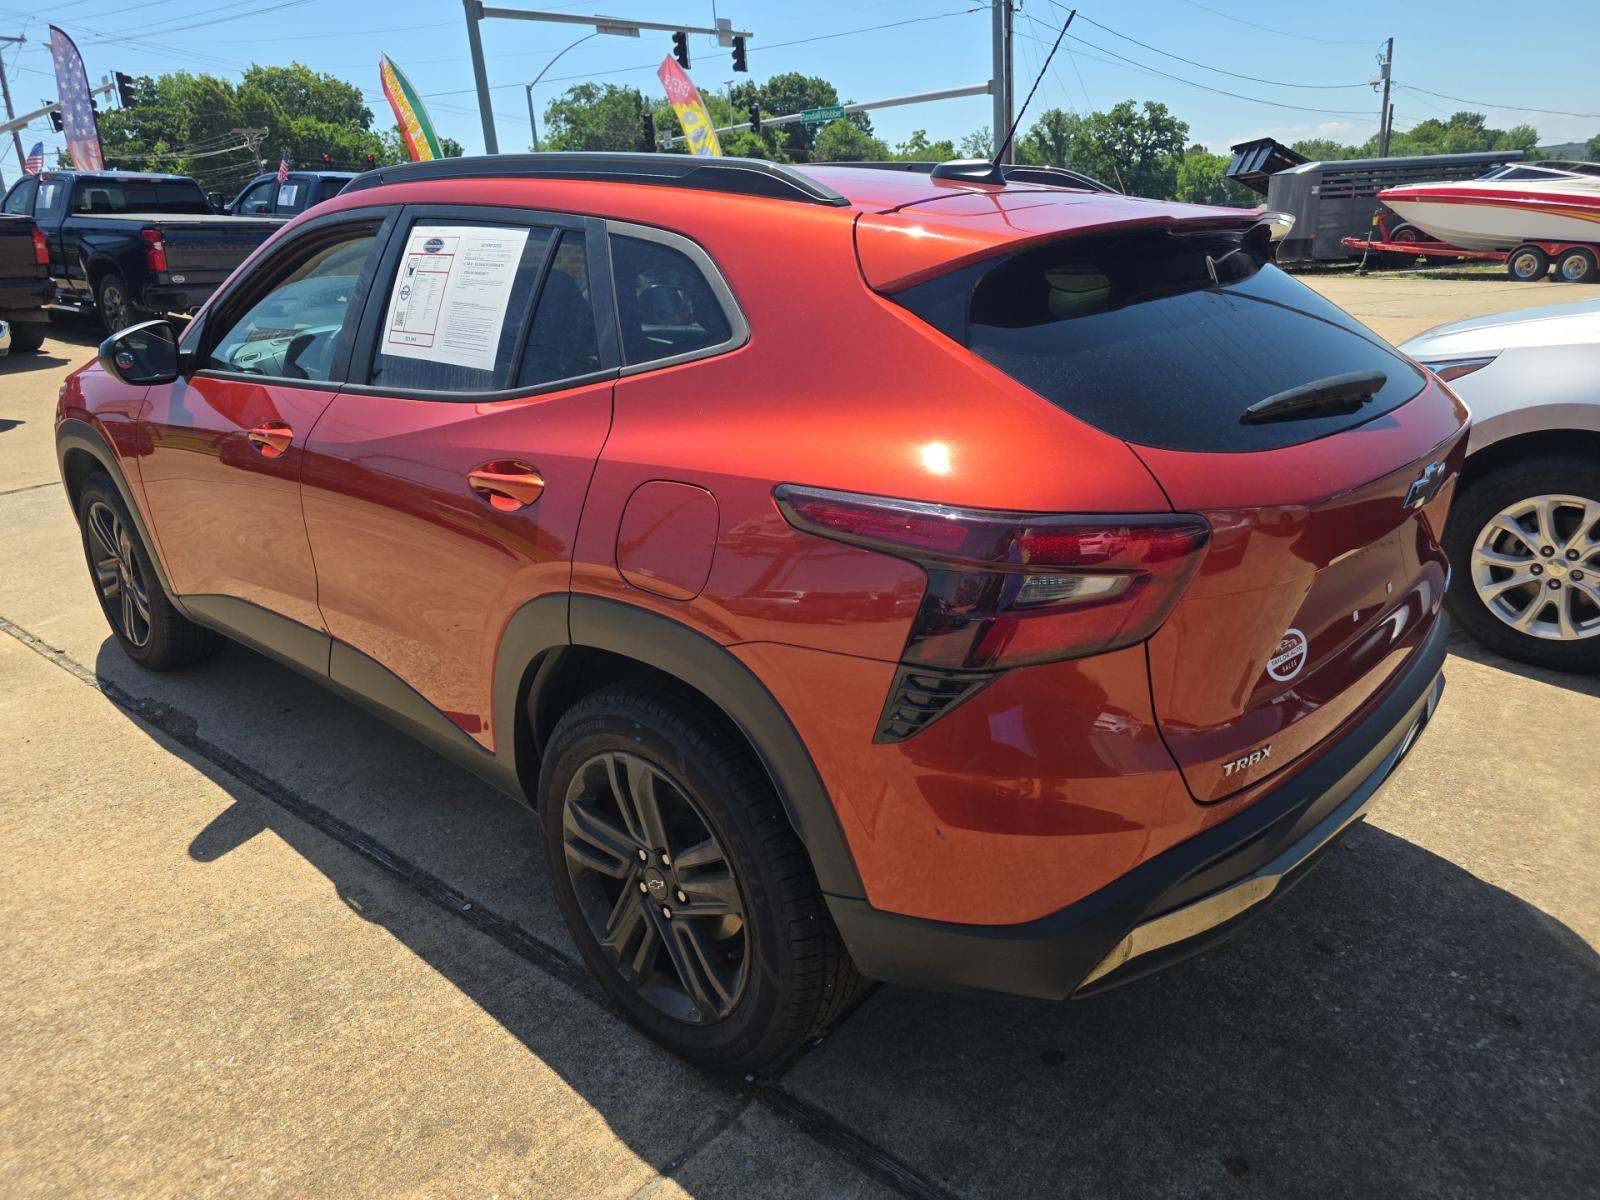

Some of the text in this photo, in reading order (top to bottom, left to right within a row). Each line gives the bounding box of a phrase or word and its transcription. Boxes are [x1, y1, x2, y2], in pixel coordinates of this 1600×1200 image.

[1271, 646, 1303, 666] TAYLOR AUTO
[1282, 660, 1297, 672] SALES
[1222, 745, 1272, 776] TRAX
